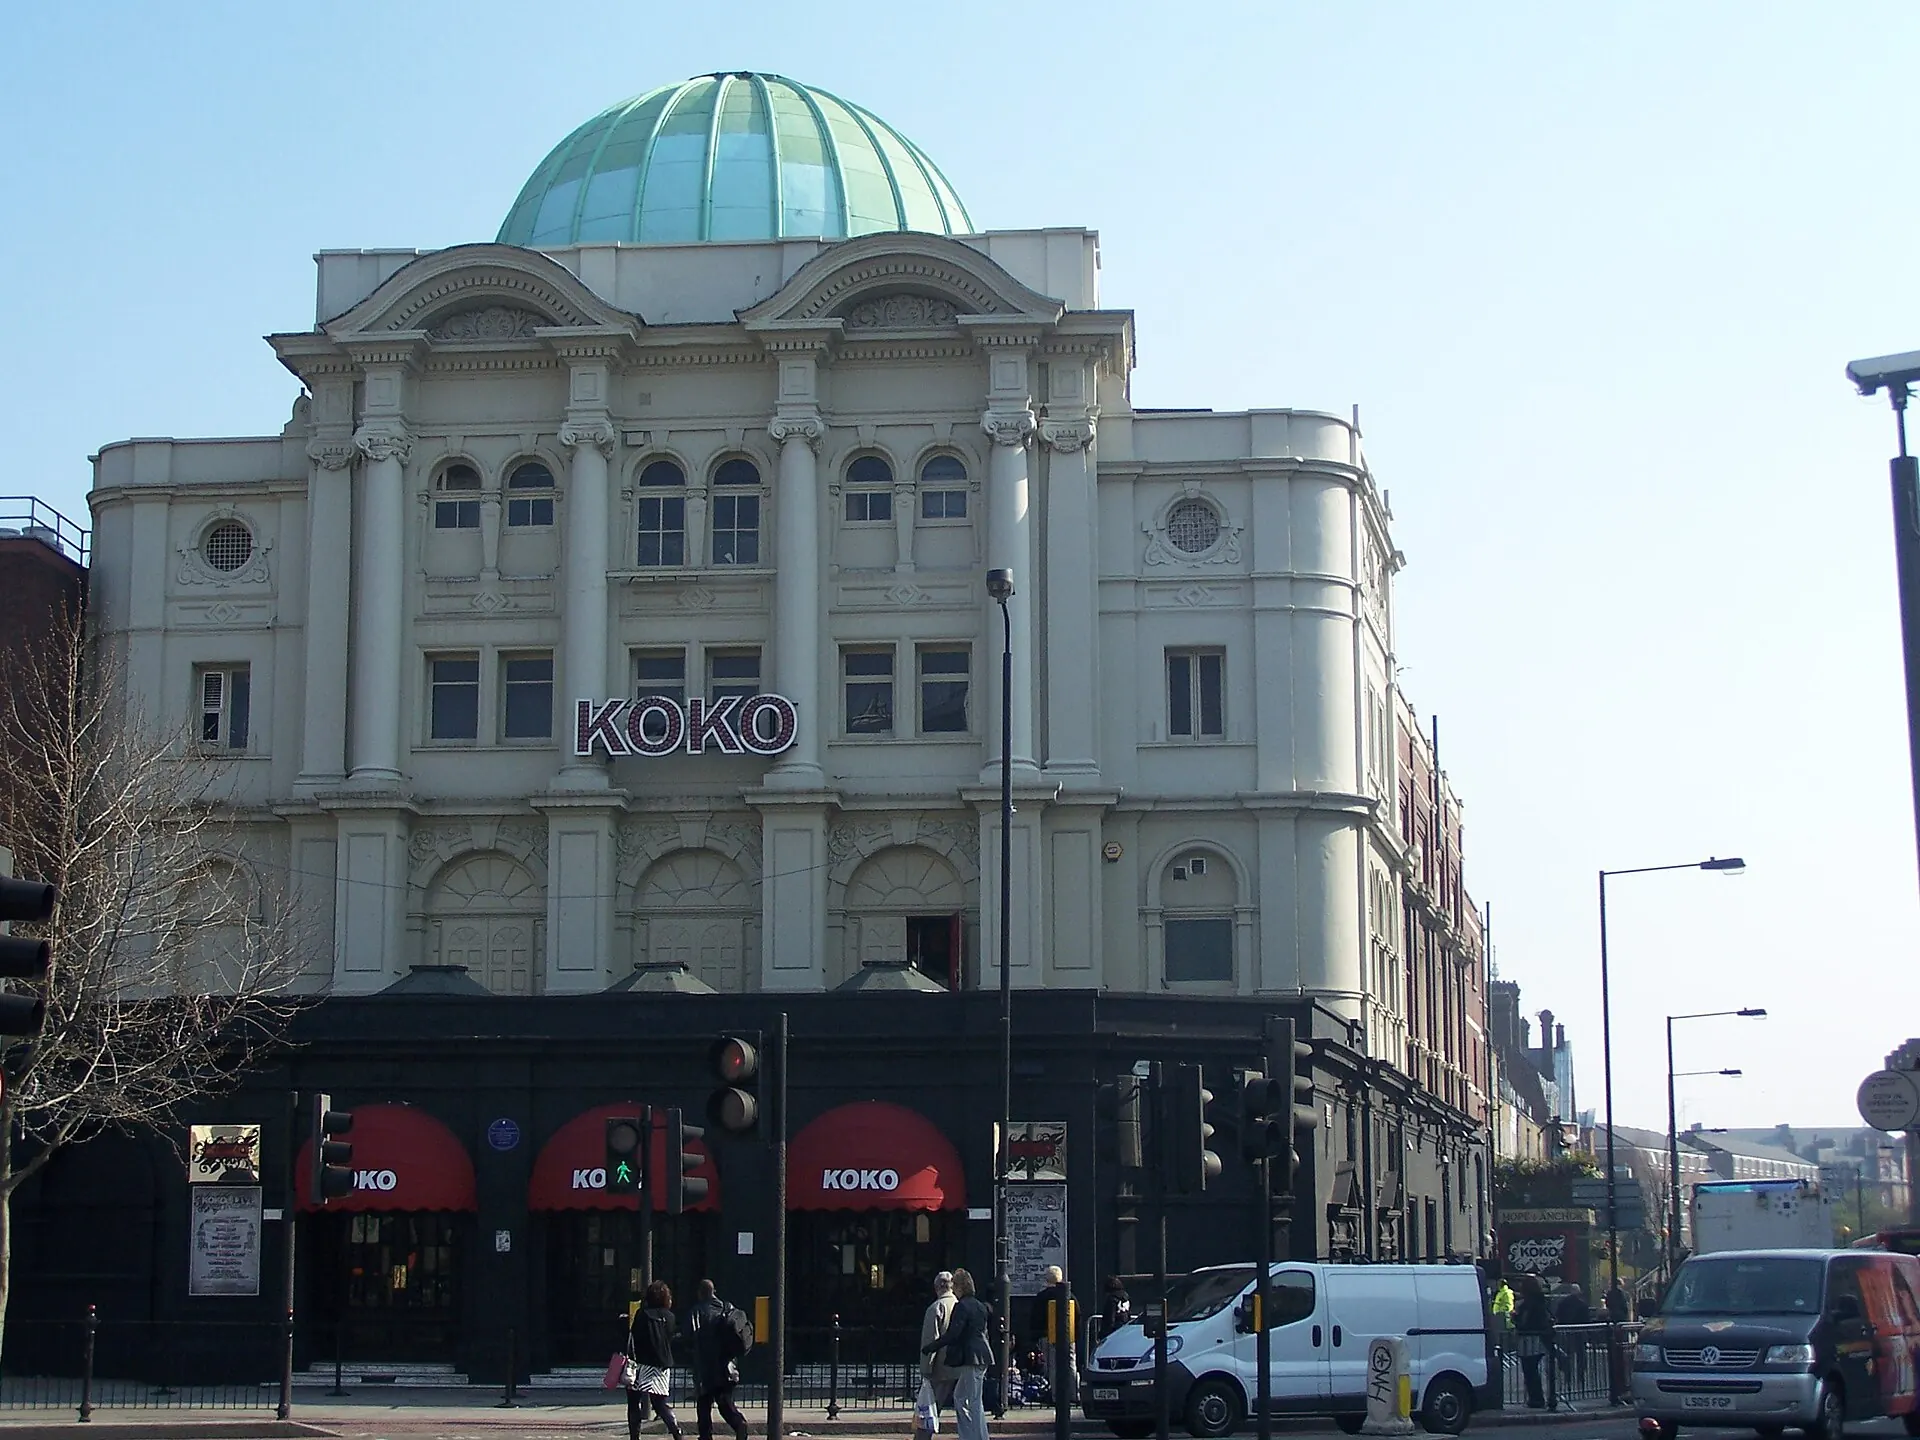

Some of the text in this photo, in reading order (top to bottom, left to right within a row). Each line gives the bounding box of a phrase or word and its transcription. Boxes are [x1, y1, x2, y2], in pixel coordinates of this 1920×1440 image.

[573, 693, 798, 757] KOKO
[353, 1170, 397, 1190] KO
[822, 1169, 899, 1190] KOKO
[1520, 1246, 1558, 1257] KOKO
